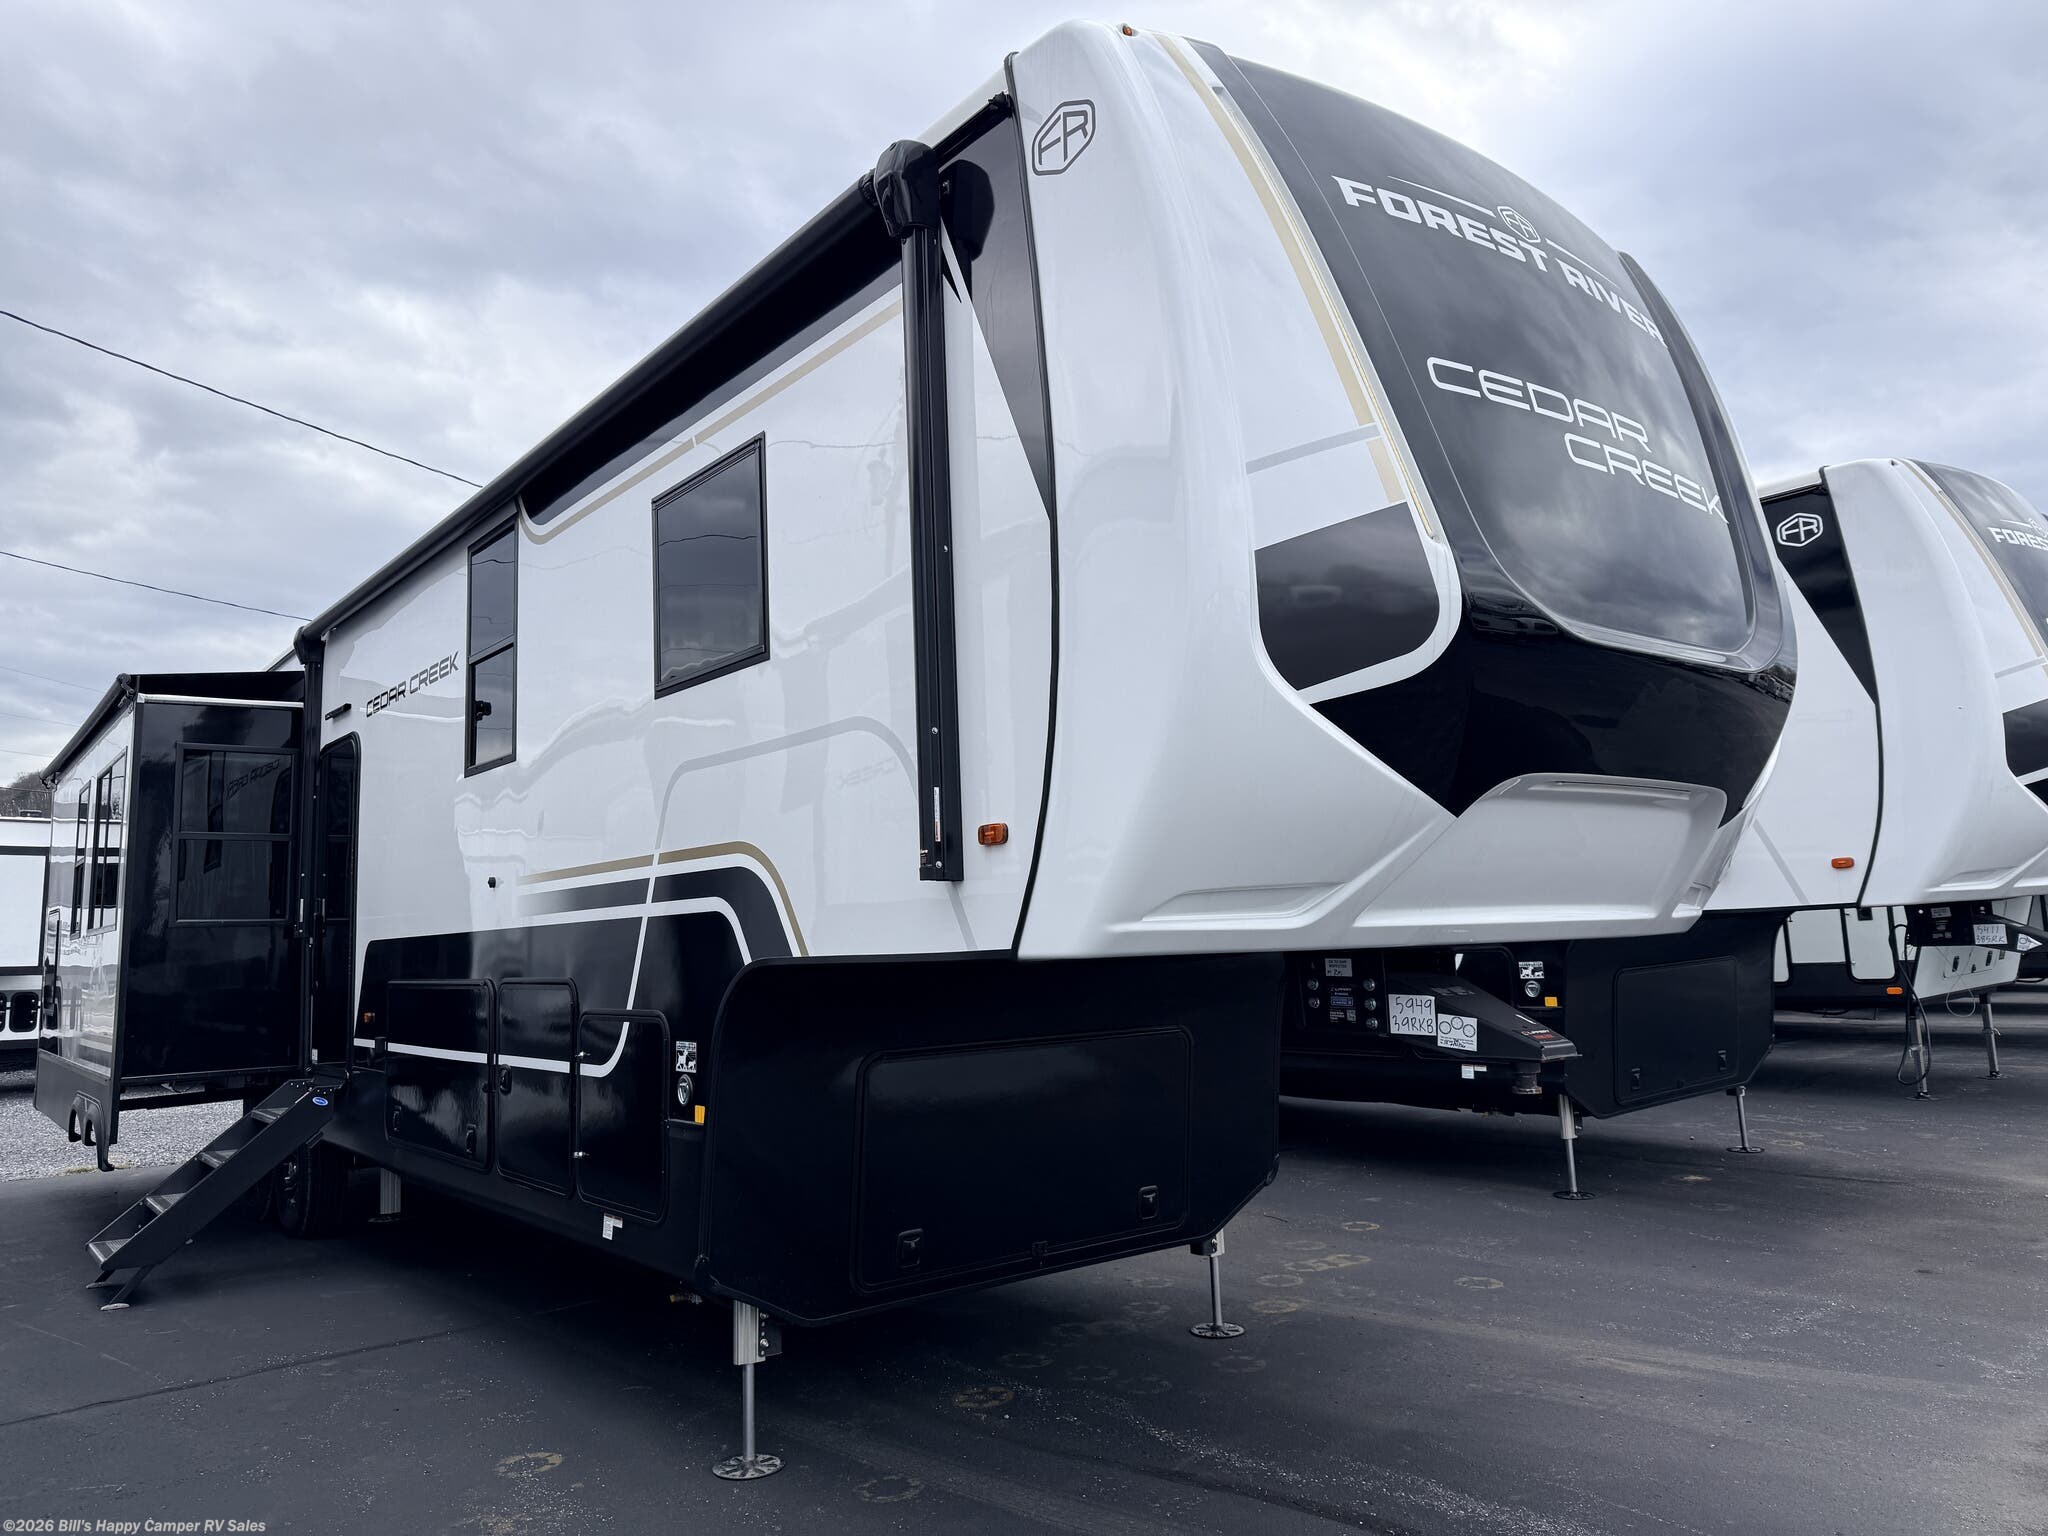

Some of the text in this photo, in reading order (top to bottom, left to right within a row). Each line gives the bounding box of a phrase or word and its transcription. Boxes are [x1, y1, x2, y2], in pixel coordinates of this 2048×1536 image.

[1331, 175, 1668, 348] FOREST RIVER
[1426, 356, 1652, 453] CEDAR
[1563, 431, 1730, 524] CREEK
[365, 651, 459, 718] CEDAR CREEK
[1391, 1014, 1434, 1034] 39RKB
[1395, 996, 1433, 1015] 5949
